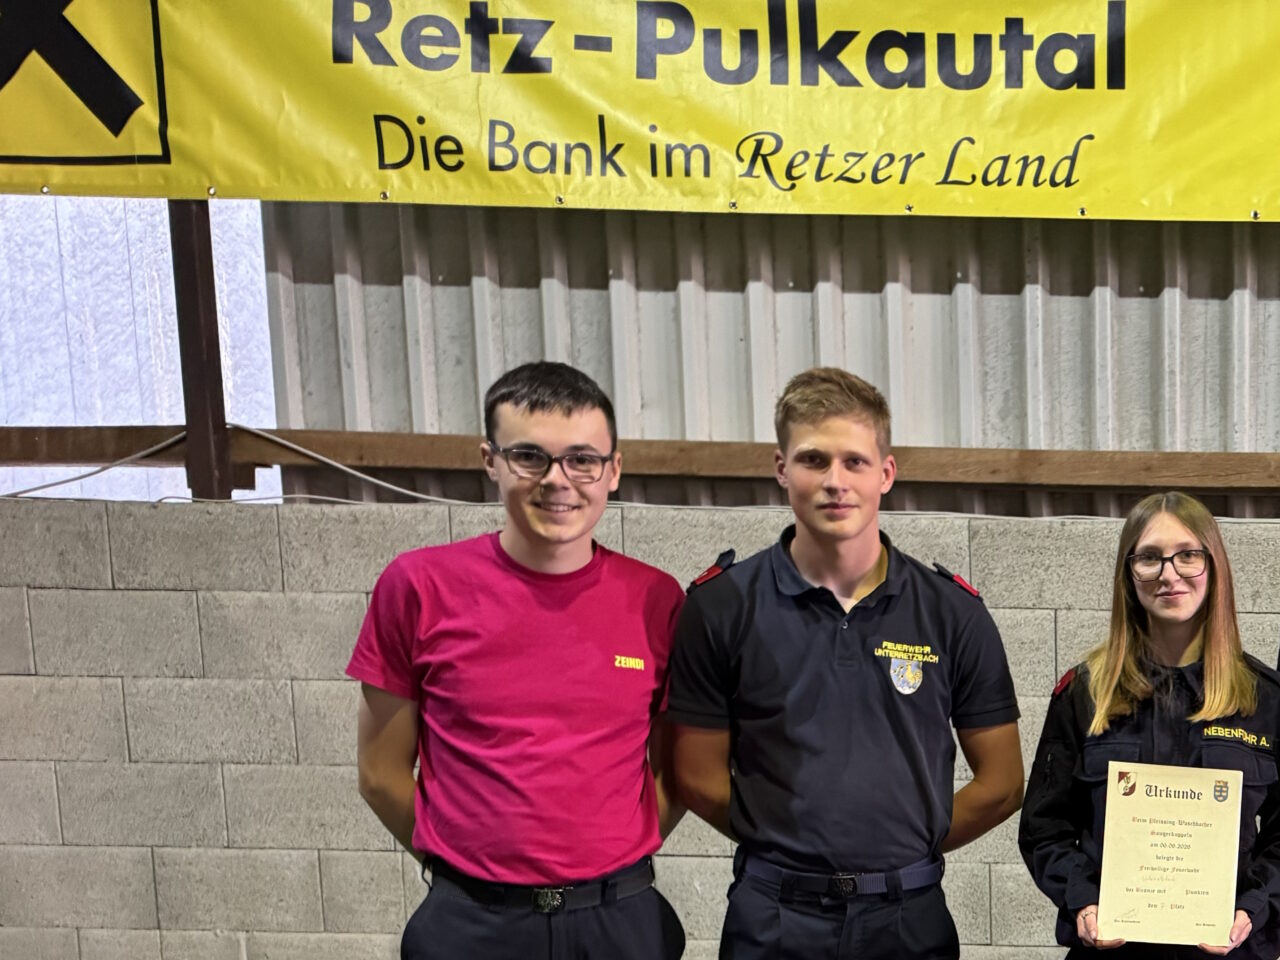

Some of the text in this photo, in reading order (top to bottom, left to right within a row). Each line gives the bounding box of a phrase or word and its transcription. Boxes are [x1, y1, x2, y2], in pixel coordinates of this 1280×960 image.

[373, 114, 1095, 192] Die Bank im Retzer Land
[882, 641, 931, 654] FEUERWEHR
[874, 648, 939, 664] UNTERRETZBACH
[1145, 784, 1203, 800] Urkunde
